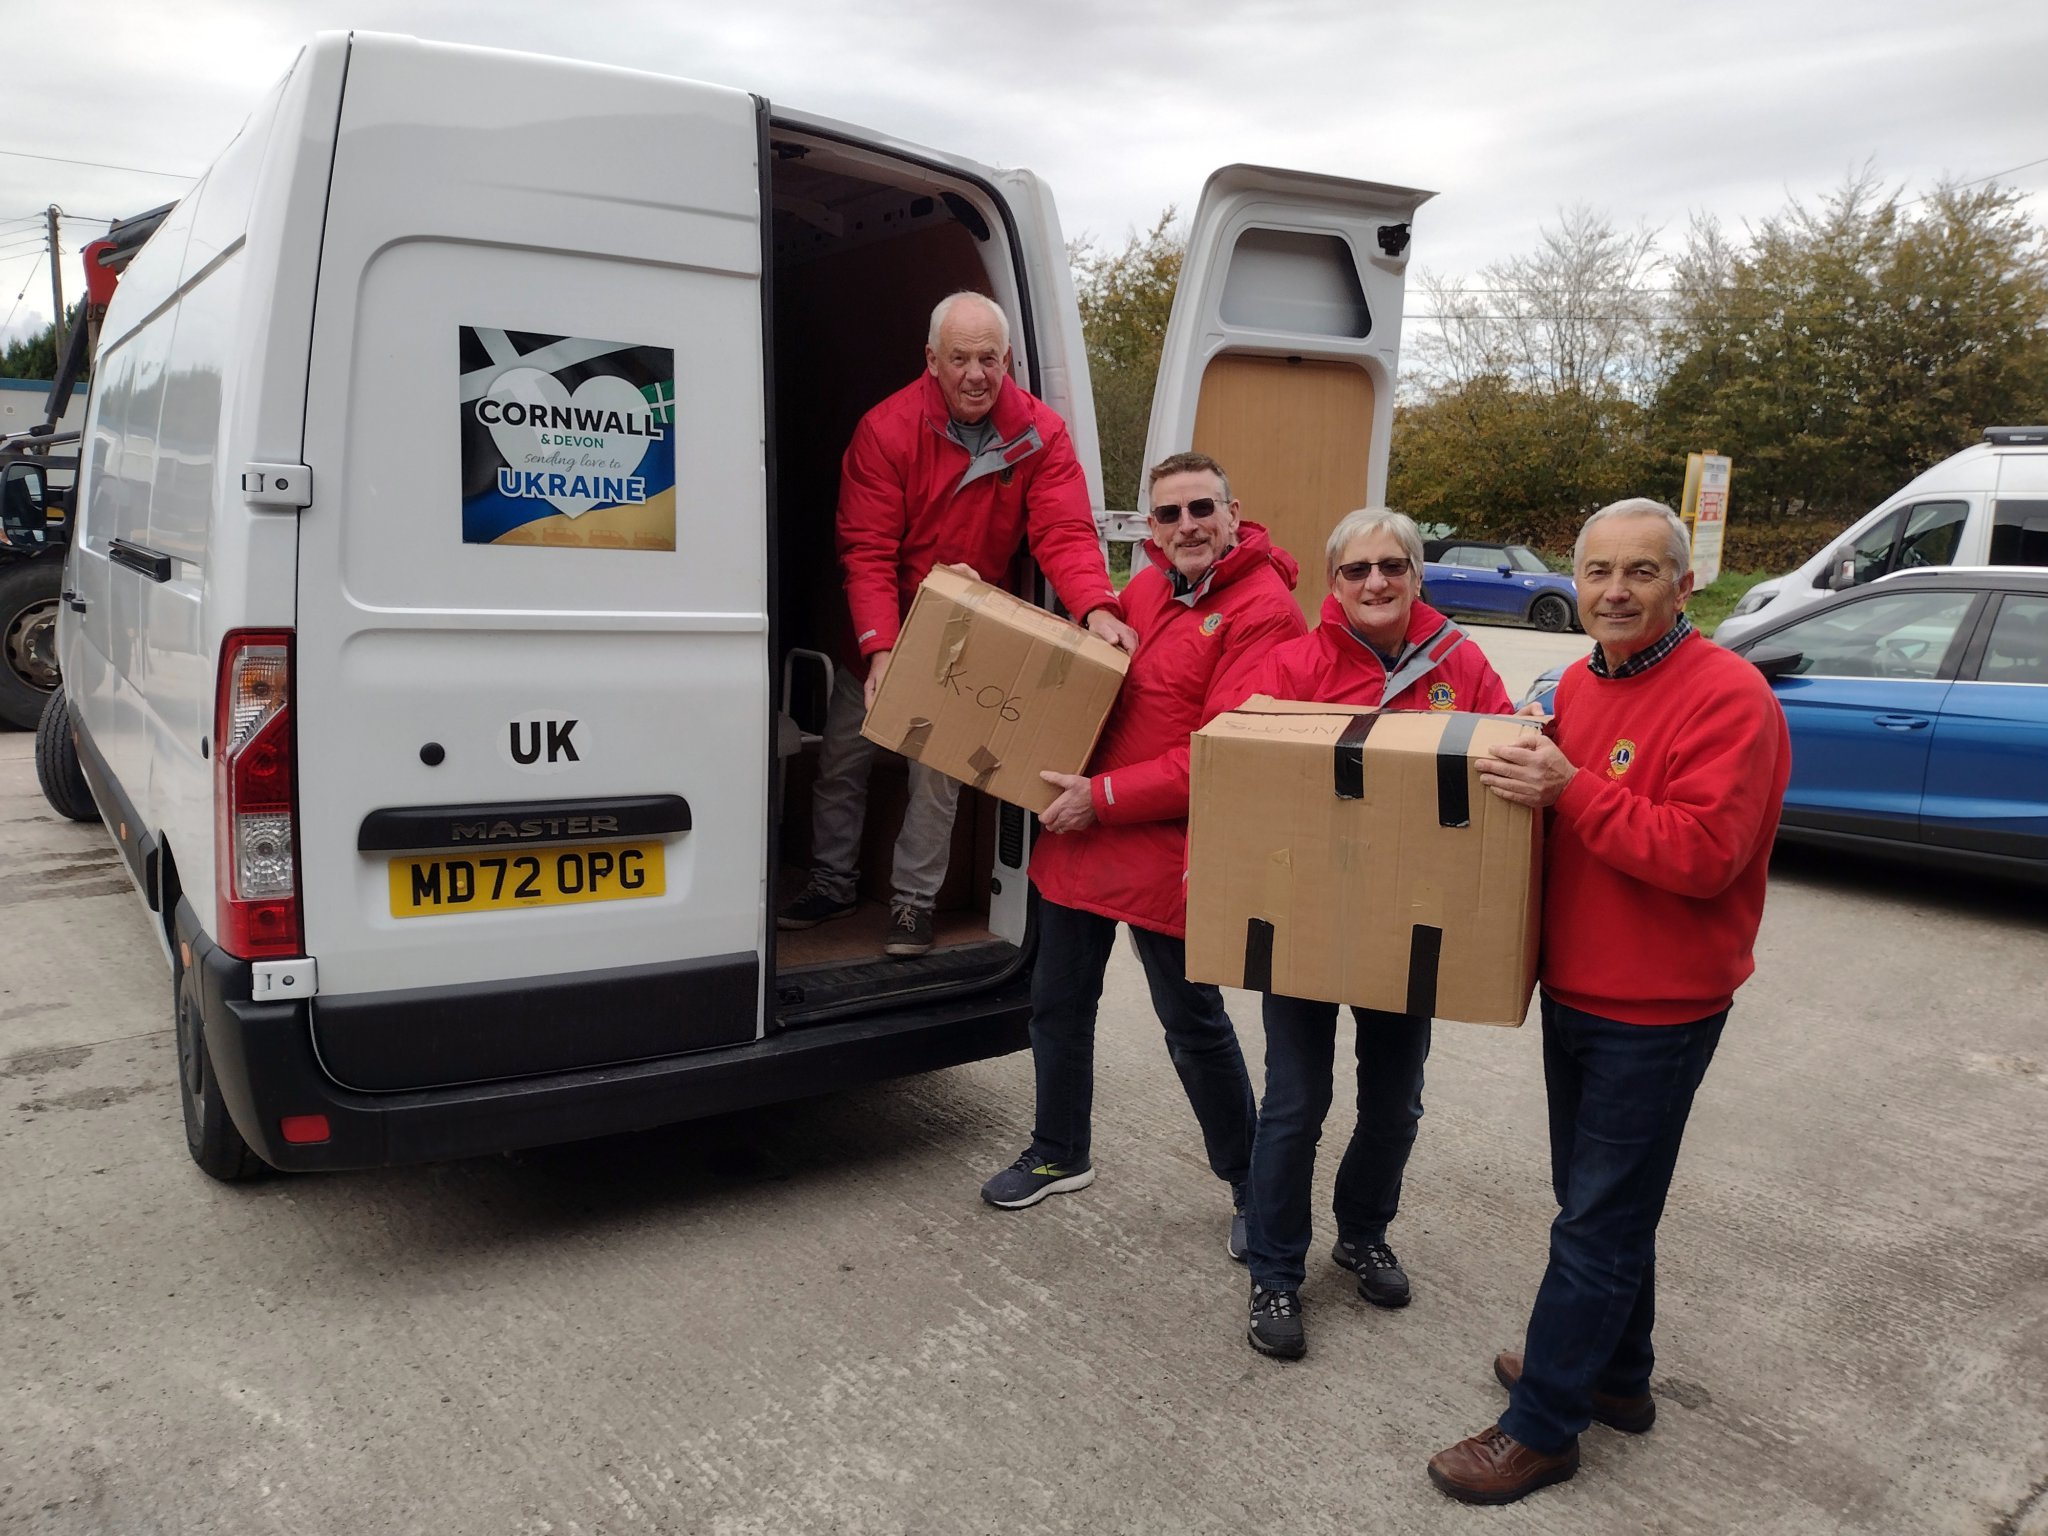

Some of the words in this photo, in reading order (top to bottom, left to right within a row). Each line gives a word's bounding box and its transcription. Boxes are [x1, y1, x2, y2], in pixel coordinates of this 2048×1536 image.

[478, 399, 662, 438] CORNWALL
[541, 433, 551, 445] &
[554, 434, 604, 449] DEVON
[524, 451, 576, 472] sending
[580, 453, 606, 468] love
[609, 458, 621, 469] to
[500, 470, 644, 502] UKRAINE
[944, 662, 1022, 722] K-06
[509, 719, 580, 765] UK
[451, 815, 619, 841] MASTER
[411, 856, 541, 906] MD72
[557, 849, 645, 895] OPG
